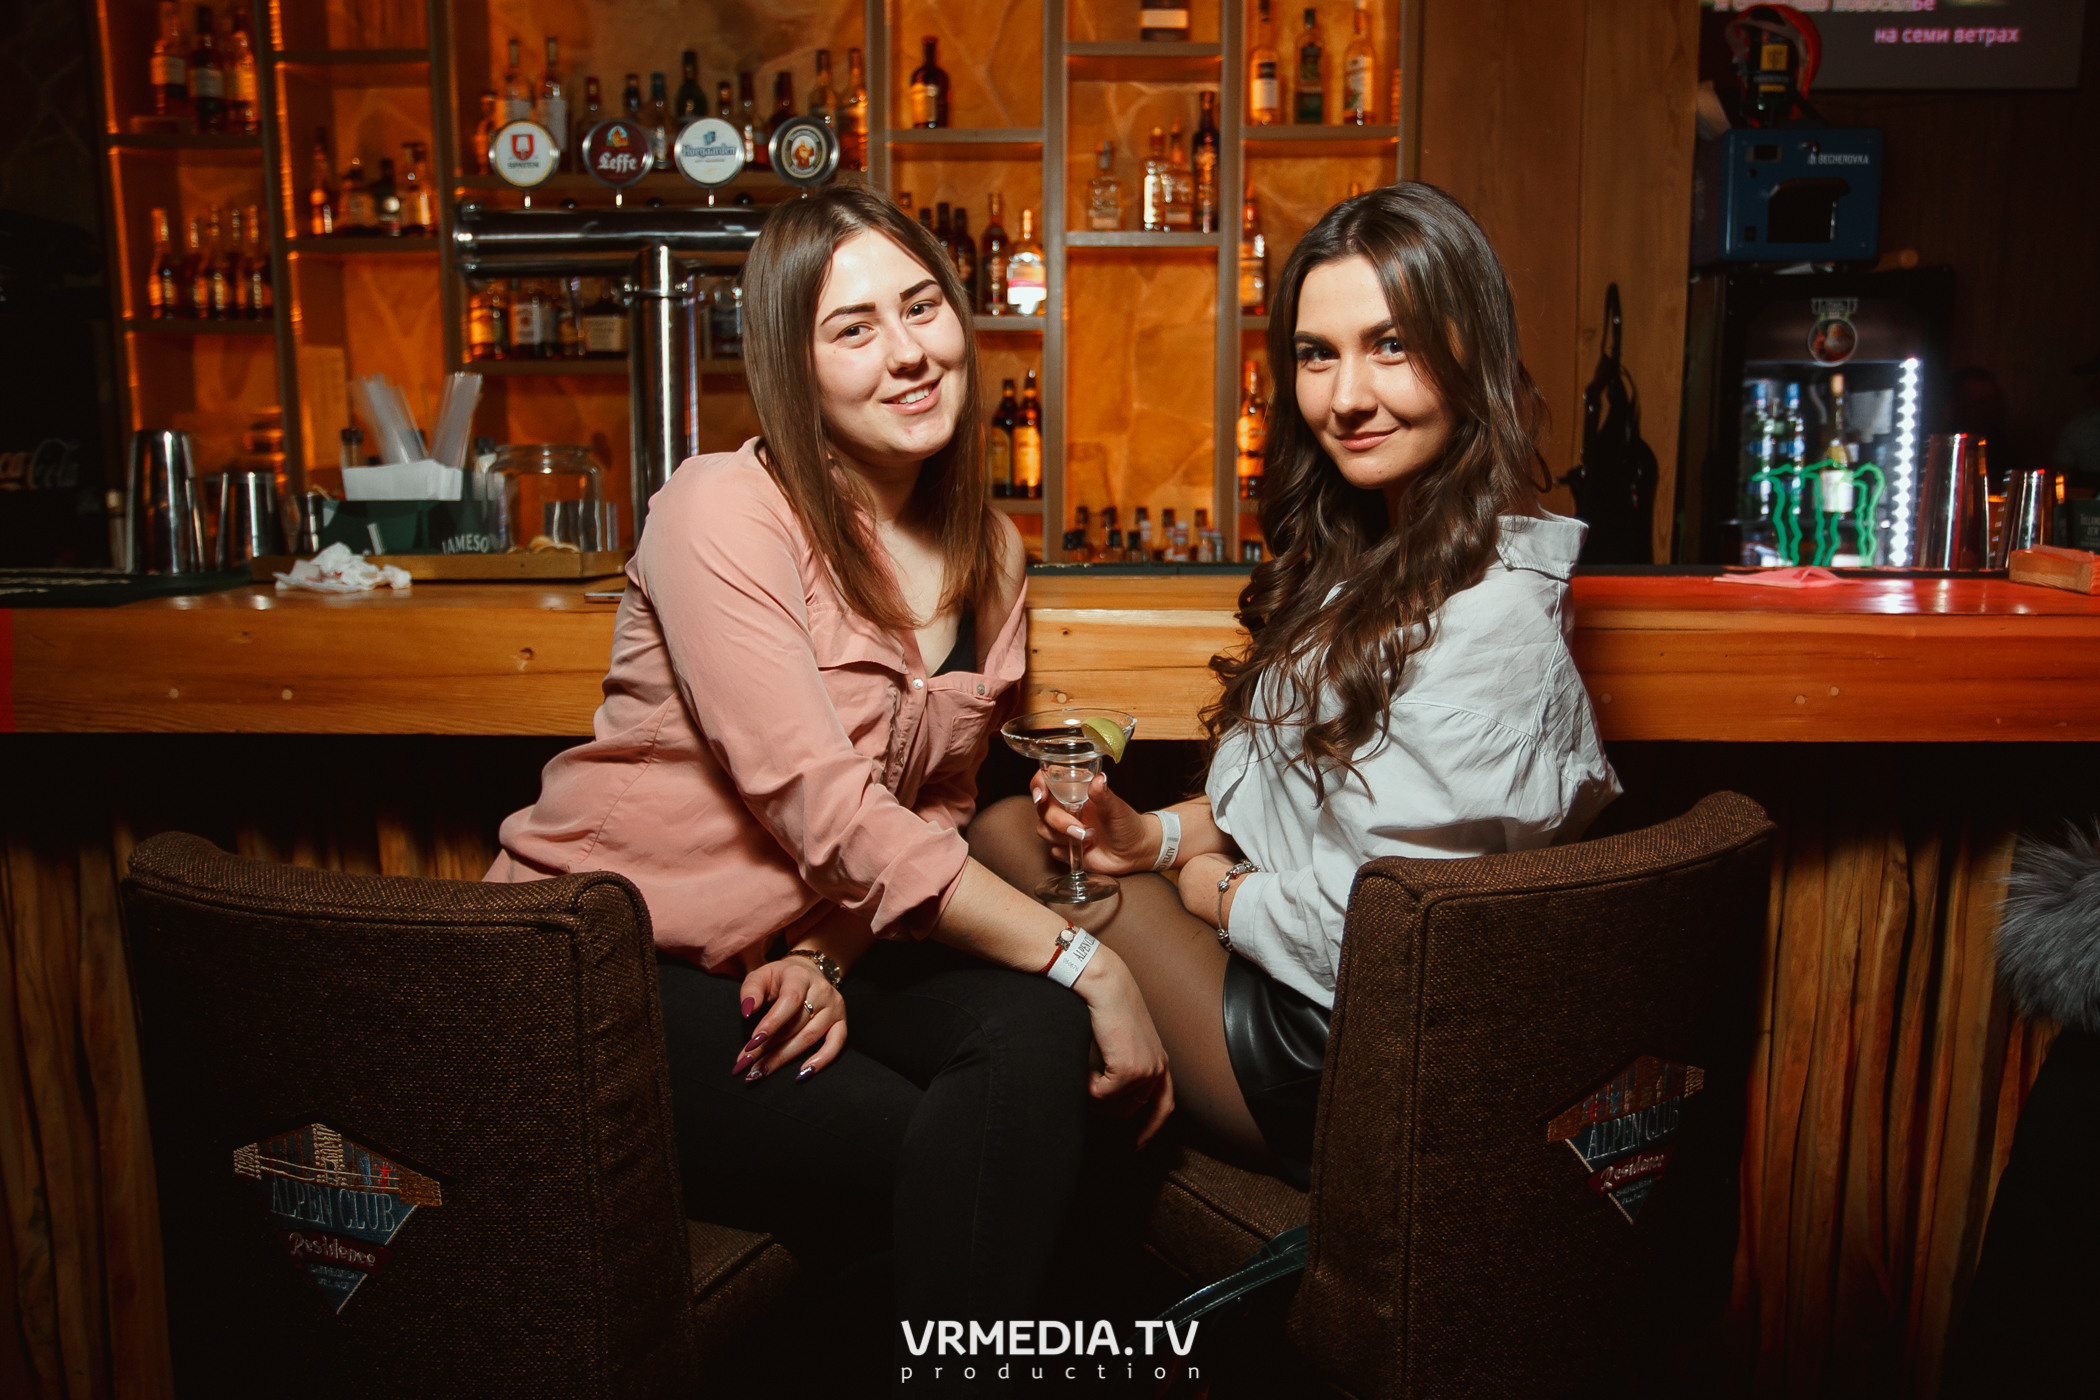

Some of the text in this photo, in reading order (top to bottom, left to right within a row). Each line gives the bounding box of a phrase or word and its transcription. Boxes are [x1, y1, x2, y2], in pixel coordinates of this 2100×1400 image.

[1875, 28, 2020, 47] на семи ветрах
[682, 143, 737, 158] Hoegaarden
[1818, 152, 1869, 165] BECHEROVKA
[597, 151, 637, 173] Leffe
[1073, 940, 1092, 962] ALPEN
[1586, 1111, 1642, 1161] ALPEN
[270, 1177, 396, 1232] ALPEN CLUB
